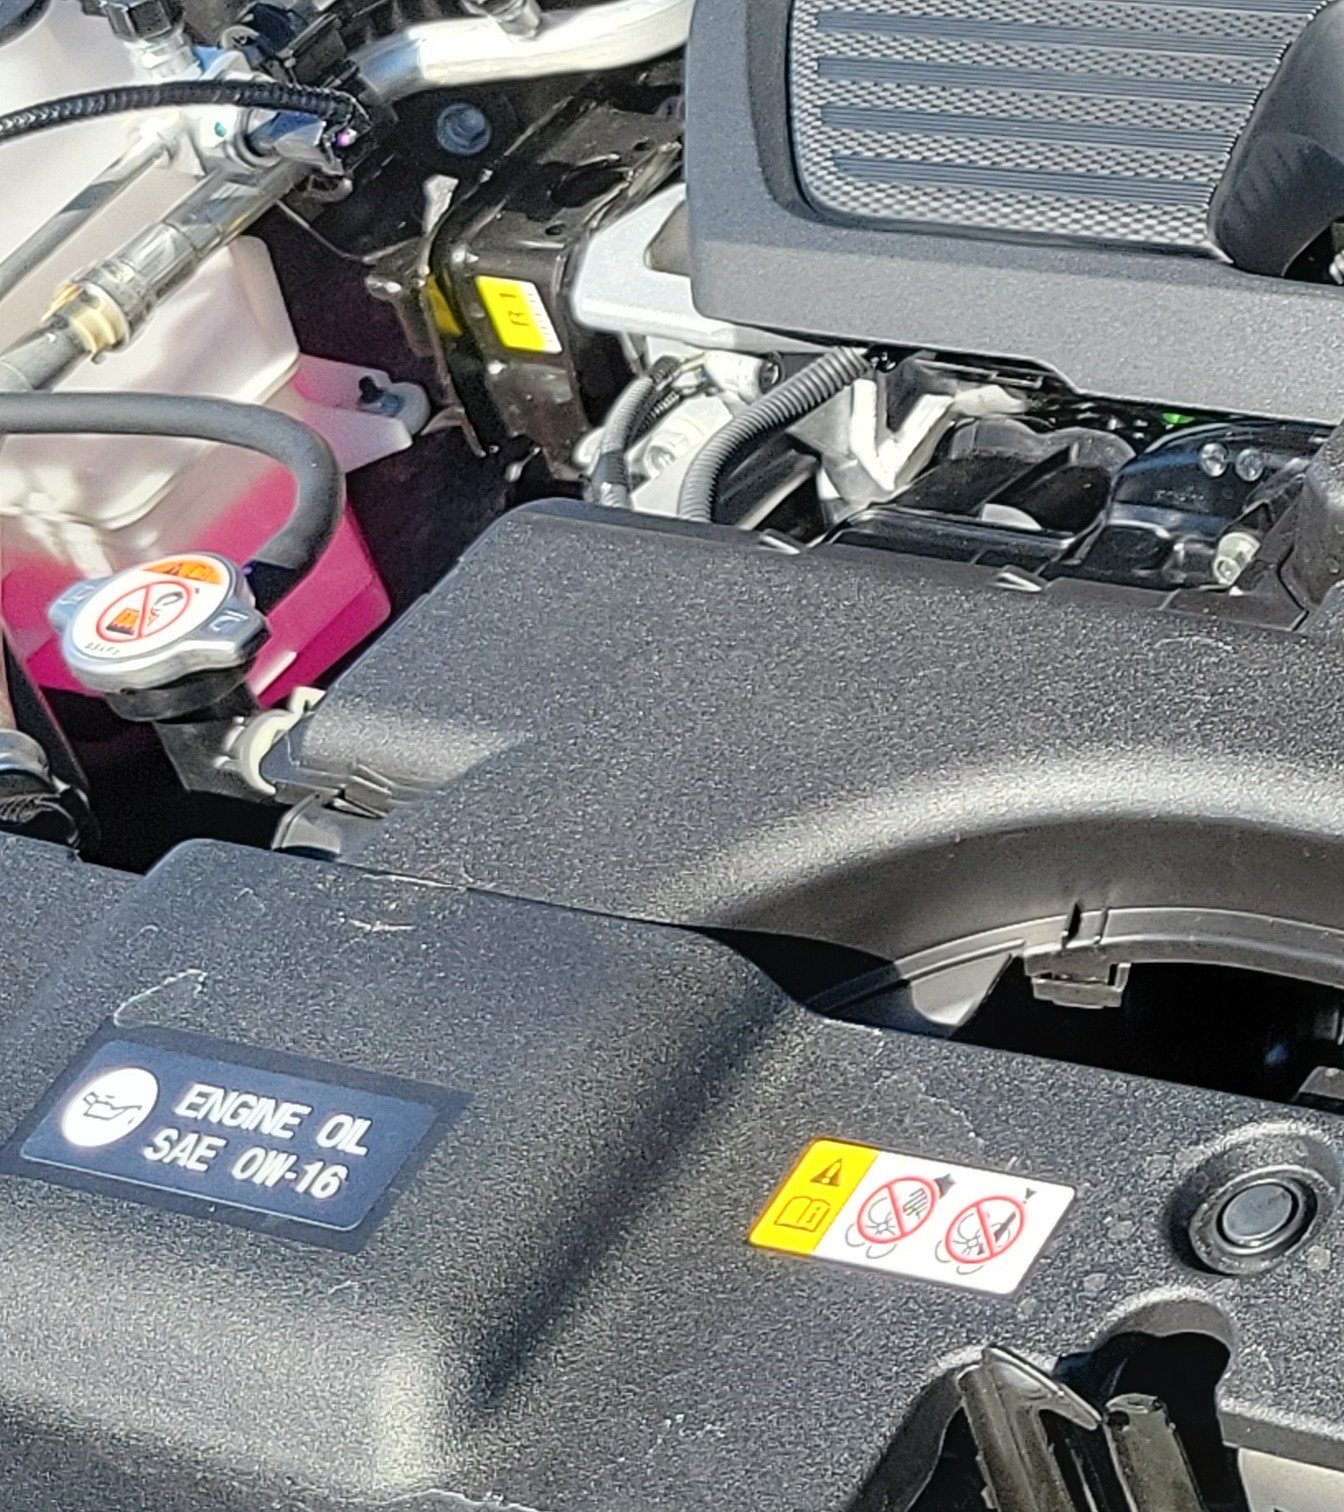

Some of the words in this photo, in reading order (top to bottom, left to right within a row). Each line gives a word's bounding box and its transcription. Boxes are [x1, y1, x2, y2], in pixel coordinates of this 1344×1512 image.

[174, 1082, 312, 1138] ENGINE
[315, 1113, 373, 1156] OIL
[143, 1129, 227, 1173] SAE
[232, 1145, 348, 1199] 0W-16
